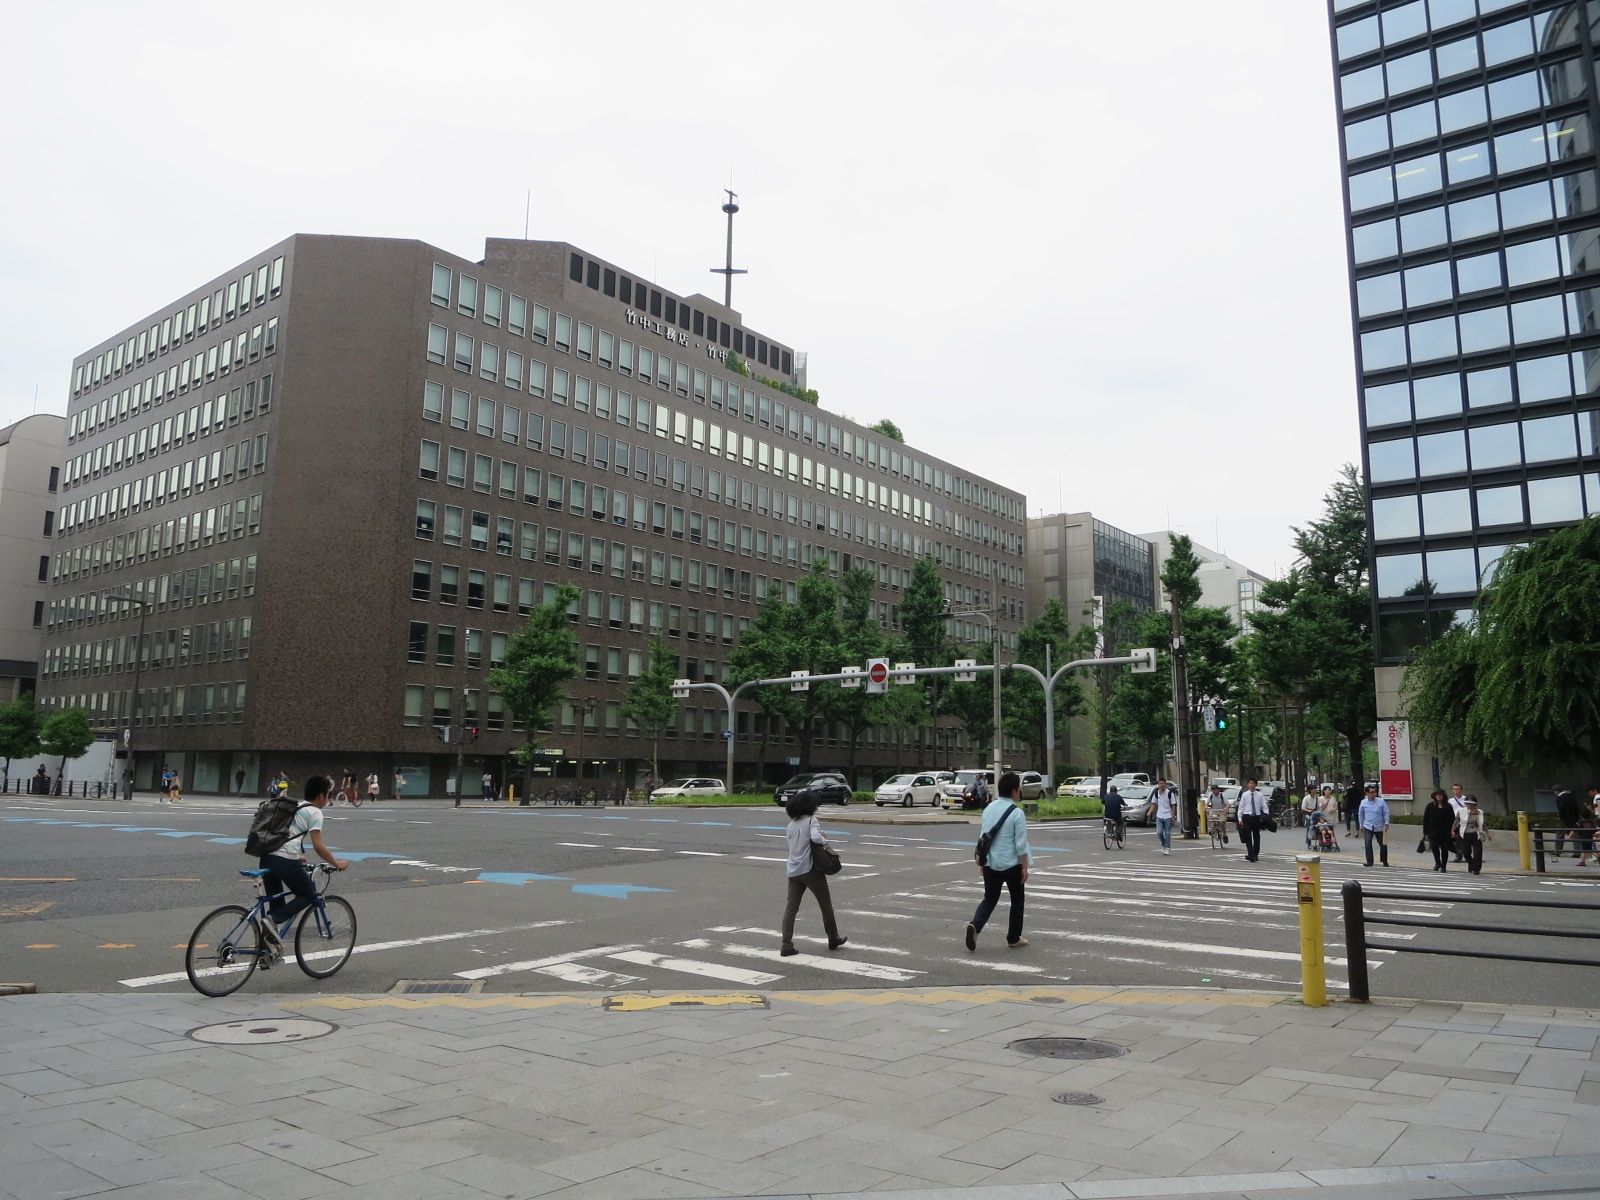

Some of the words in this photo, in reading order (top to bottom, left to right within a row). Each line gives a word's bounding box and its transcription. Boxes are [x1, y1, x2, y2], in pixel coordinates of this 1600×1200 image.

[626, 309, 752, 373] 竹中工務店・竹中木
[1388, 724, 1398, 767] docomo
